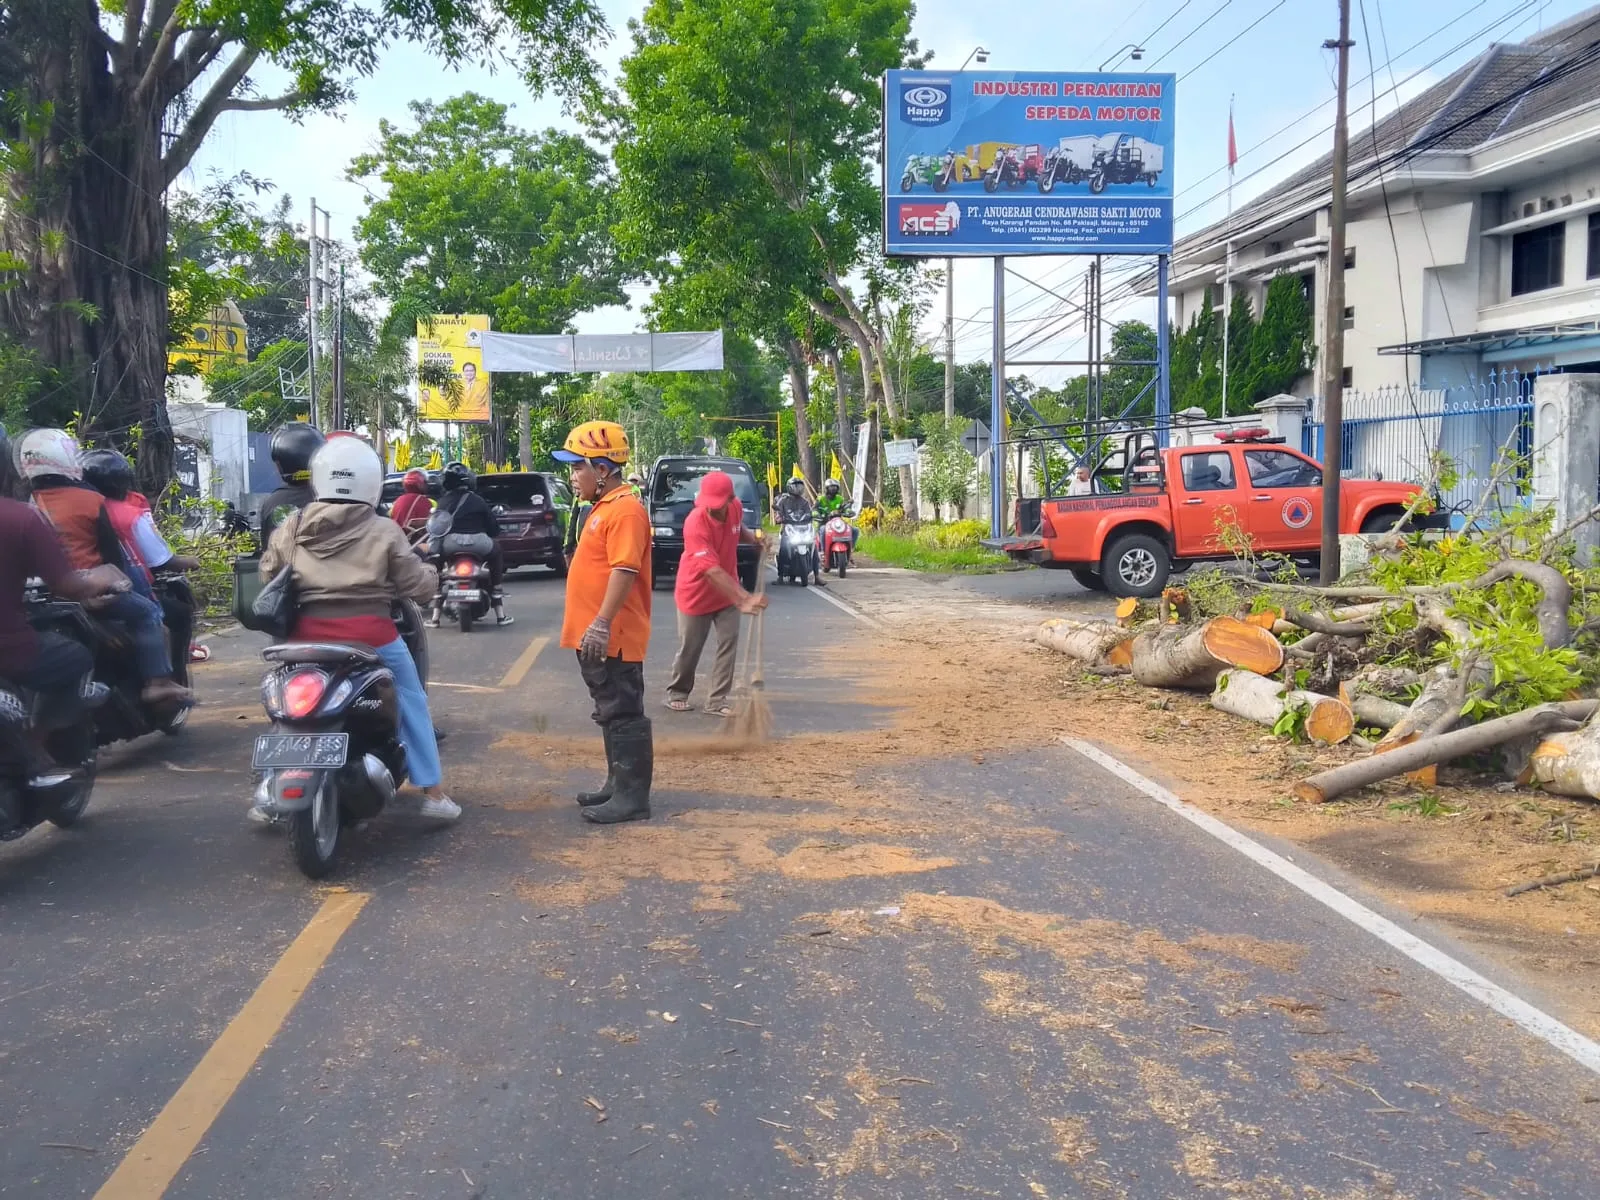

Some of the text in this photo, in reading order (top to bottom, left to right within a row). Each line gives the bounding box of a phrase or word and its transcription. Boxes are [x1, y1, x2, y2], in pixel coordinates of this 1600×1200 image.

[973, 81, 1162, 97] INDUSTRI PERAKITAN
[907, 106, 944, 117] Happy
[1025, 105, 1162, 121] SEPEDA MOTOR
[967, 206, 1162, 218] PT. ANUGERAH CENDRAWASIH SAKTI MOTOR
[1100, 219, 1125, 227] Malang
